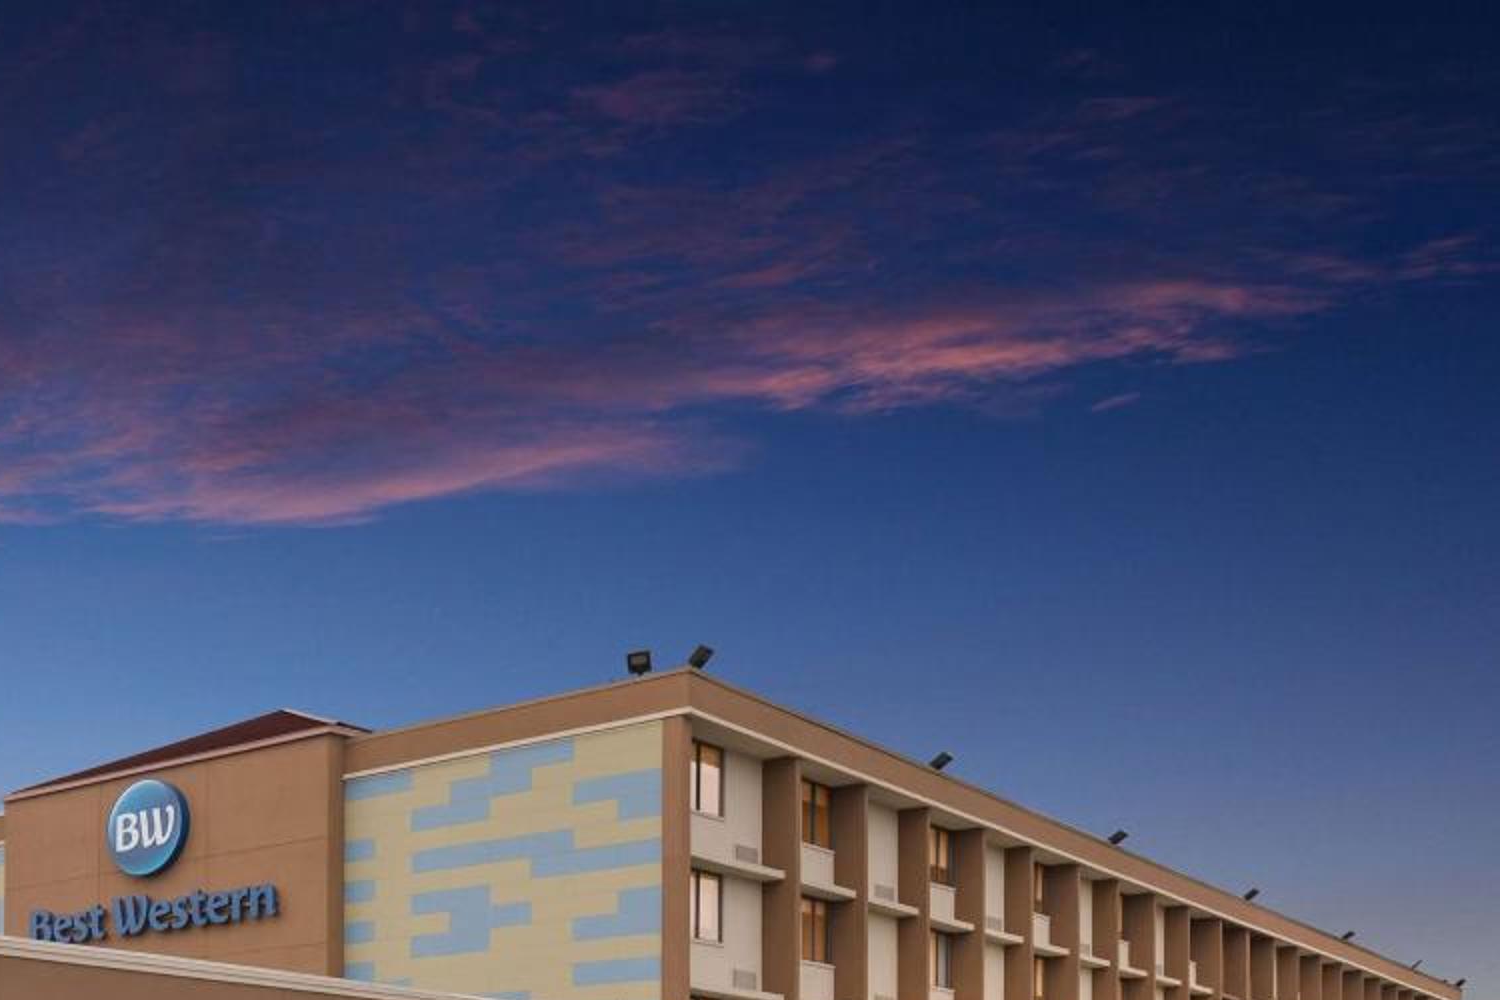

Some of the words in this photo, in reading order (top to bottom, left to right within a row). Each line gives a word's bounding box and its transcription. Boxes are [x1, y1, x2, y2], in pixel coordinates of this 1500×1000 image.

[115, 804, 175, 853] BW
[30, 905, 106, 943] Best
[112, 884, 277, 937] Western
